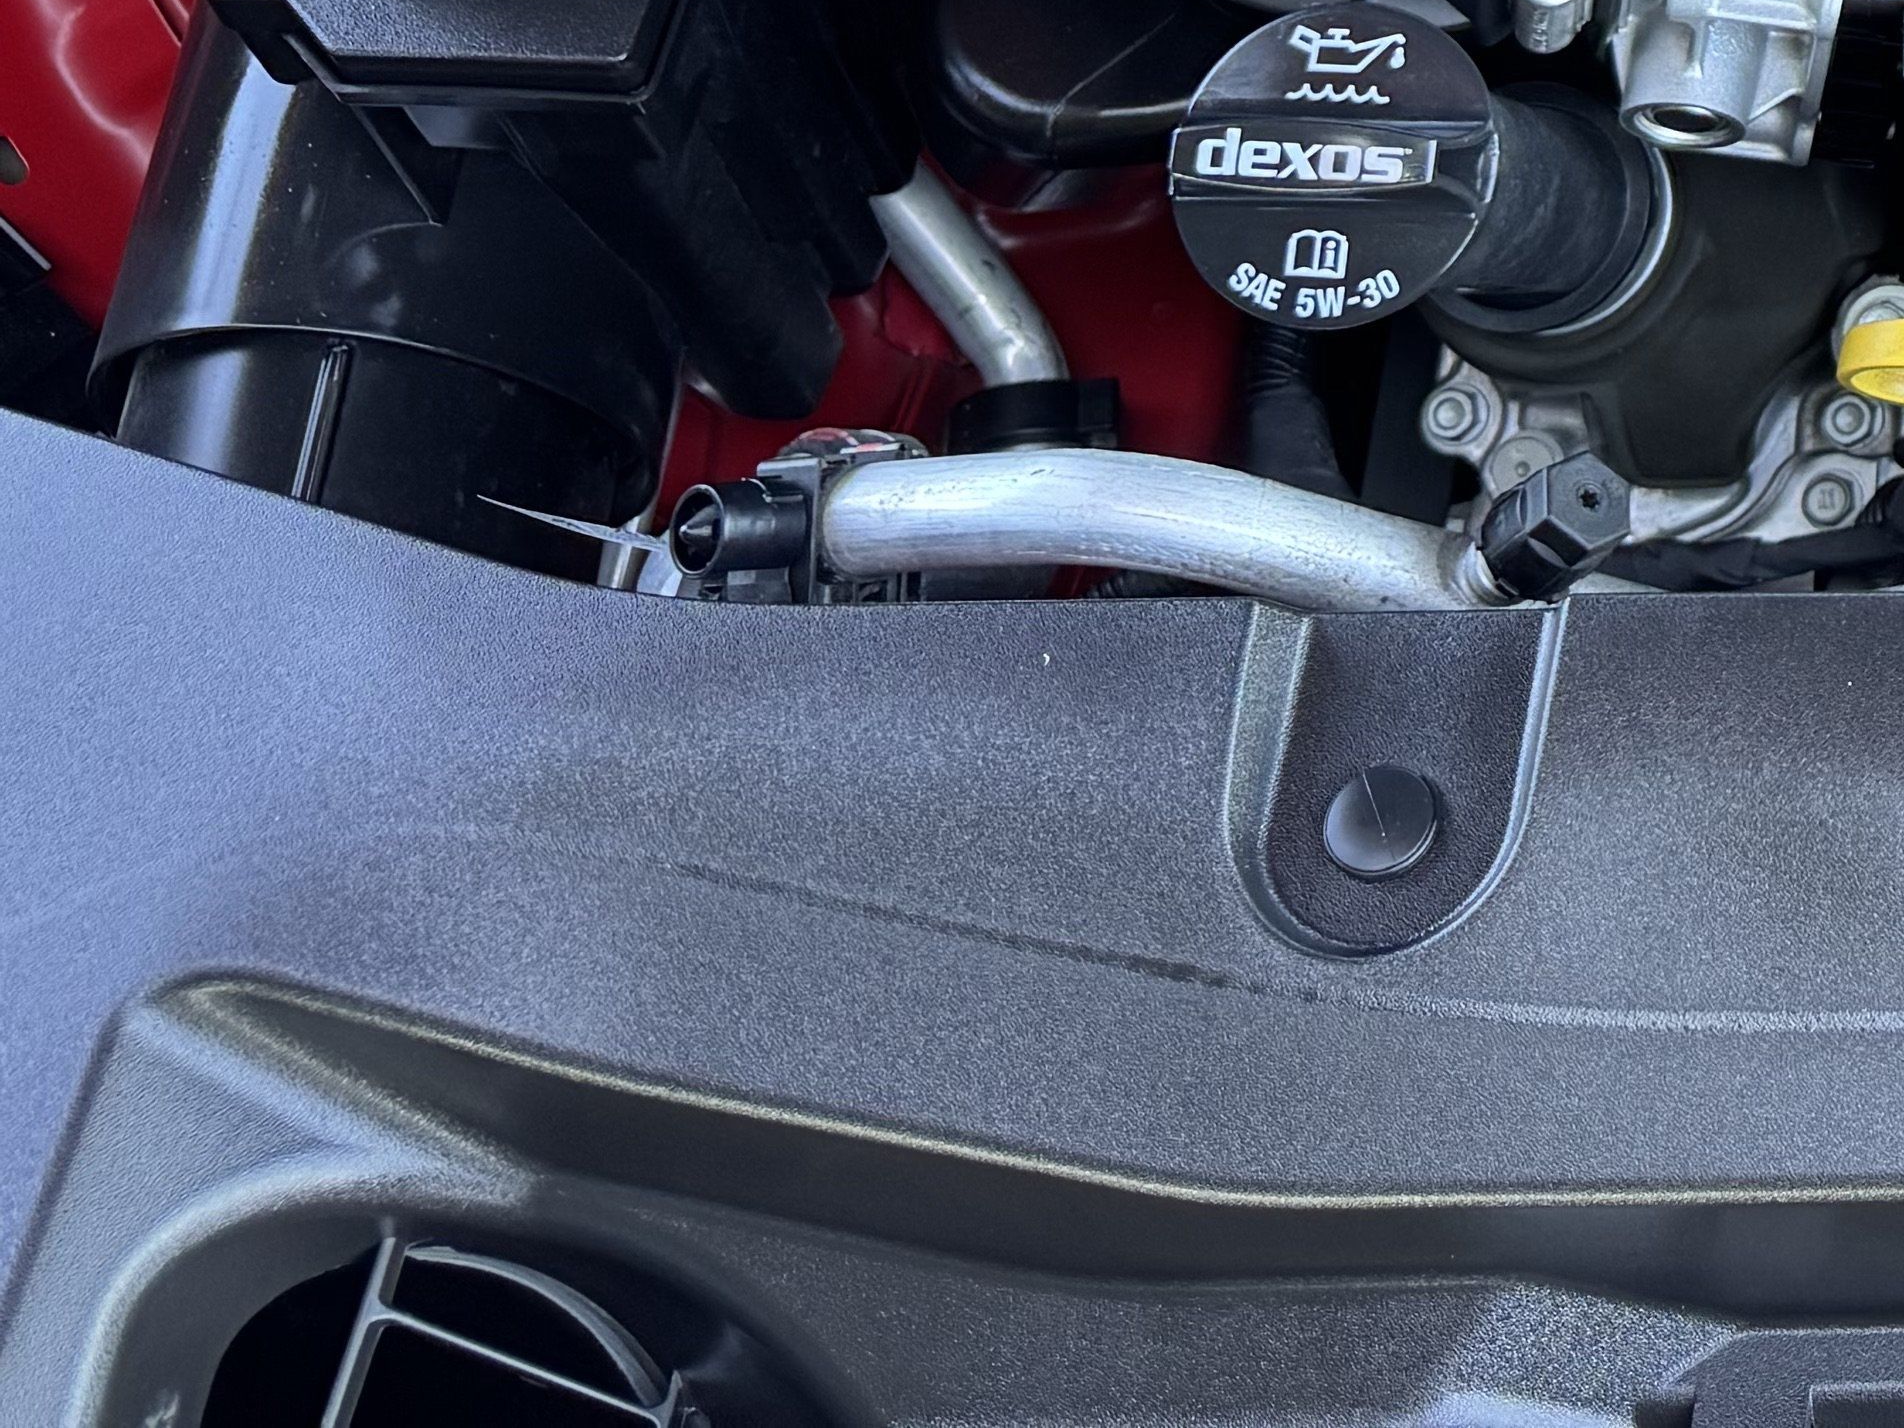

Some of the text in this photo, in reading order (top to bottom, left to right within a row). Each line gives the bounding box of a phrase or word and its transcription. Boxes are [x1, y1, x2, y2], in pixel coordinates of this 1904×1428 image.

[1195, 127, 1404, 184] dexos
[1228, 262, 1401, 318] SAE 5W-30
